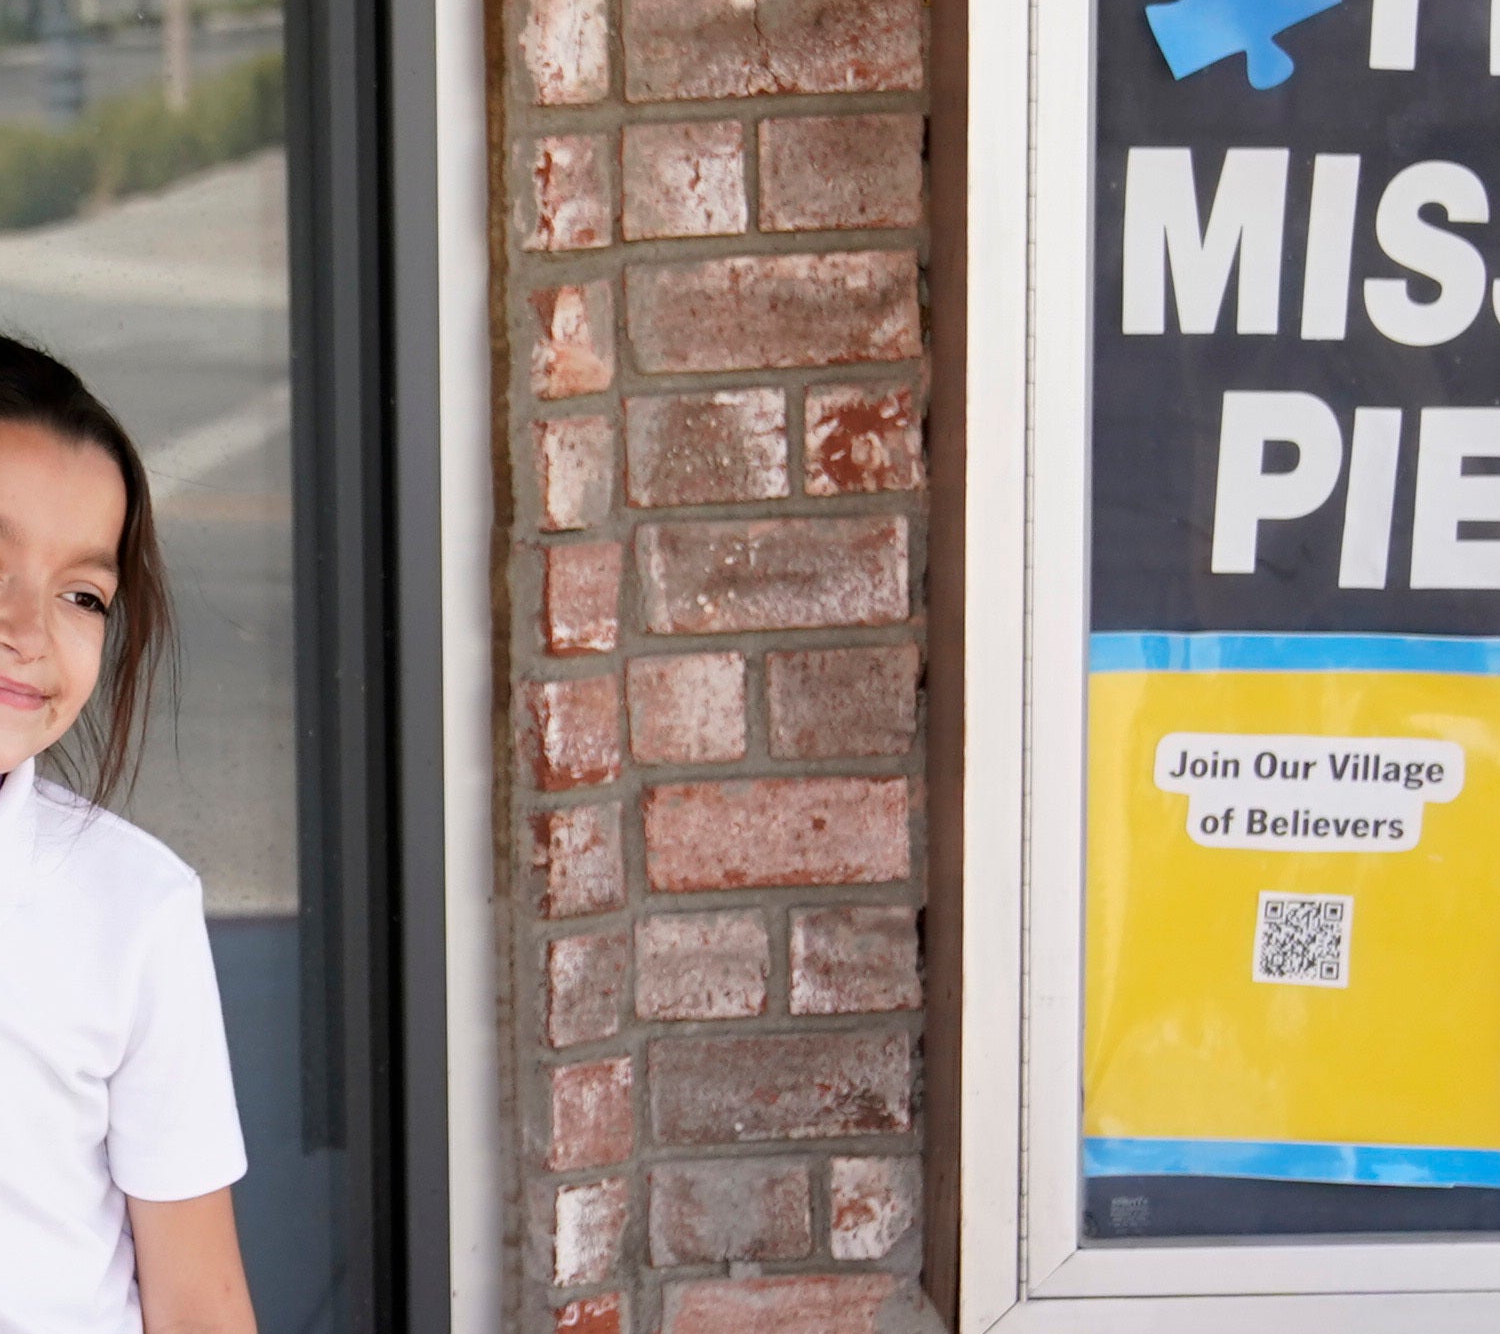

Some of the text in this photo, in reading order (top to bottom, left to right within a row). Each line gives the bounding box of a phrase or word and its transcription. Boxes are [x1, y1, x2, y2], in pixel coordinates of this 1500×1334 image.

[1169, 750, 1445, 790] Join Our Village
[1200, 807, 1405, 839] of Believers
